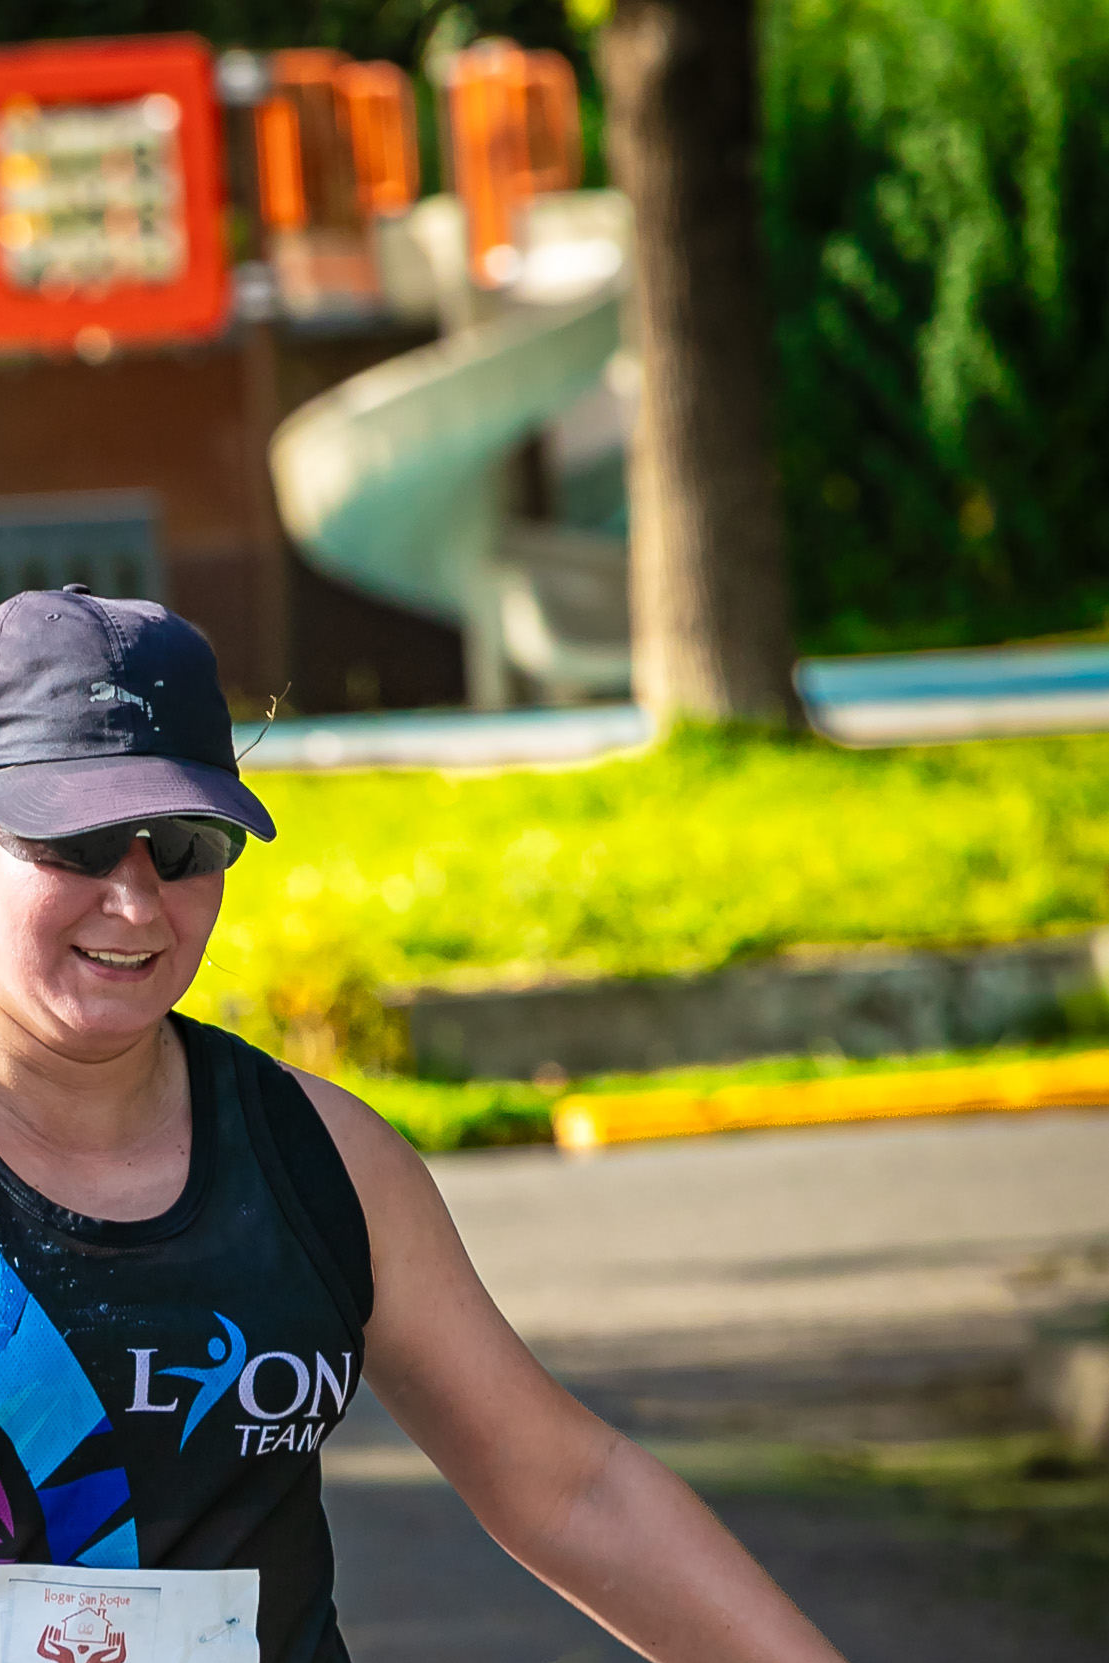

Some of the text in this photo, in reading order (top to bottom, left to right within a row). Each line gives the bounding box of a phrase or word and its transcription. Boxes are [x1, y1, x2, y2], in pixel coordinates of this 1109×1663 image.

[234, 1421, 326, 1457] TEAM
[44, 1588, 132, 1609] Hogar San Roque
